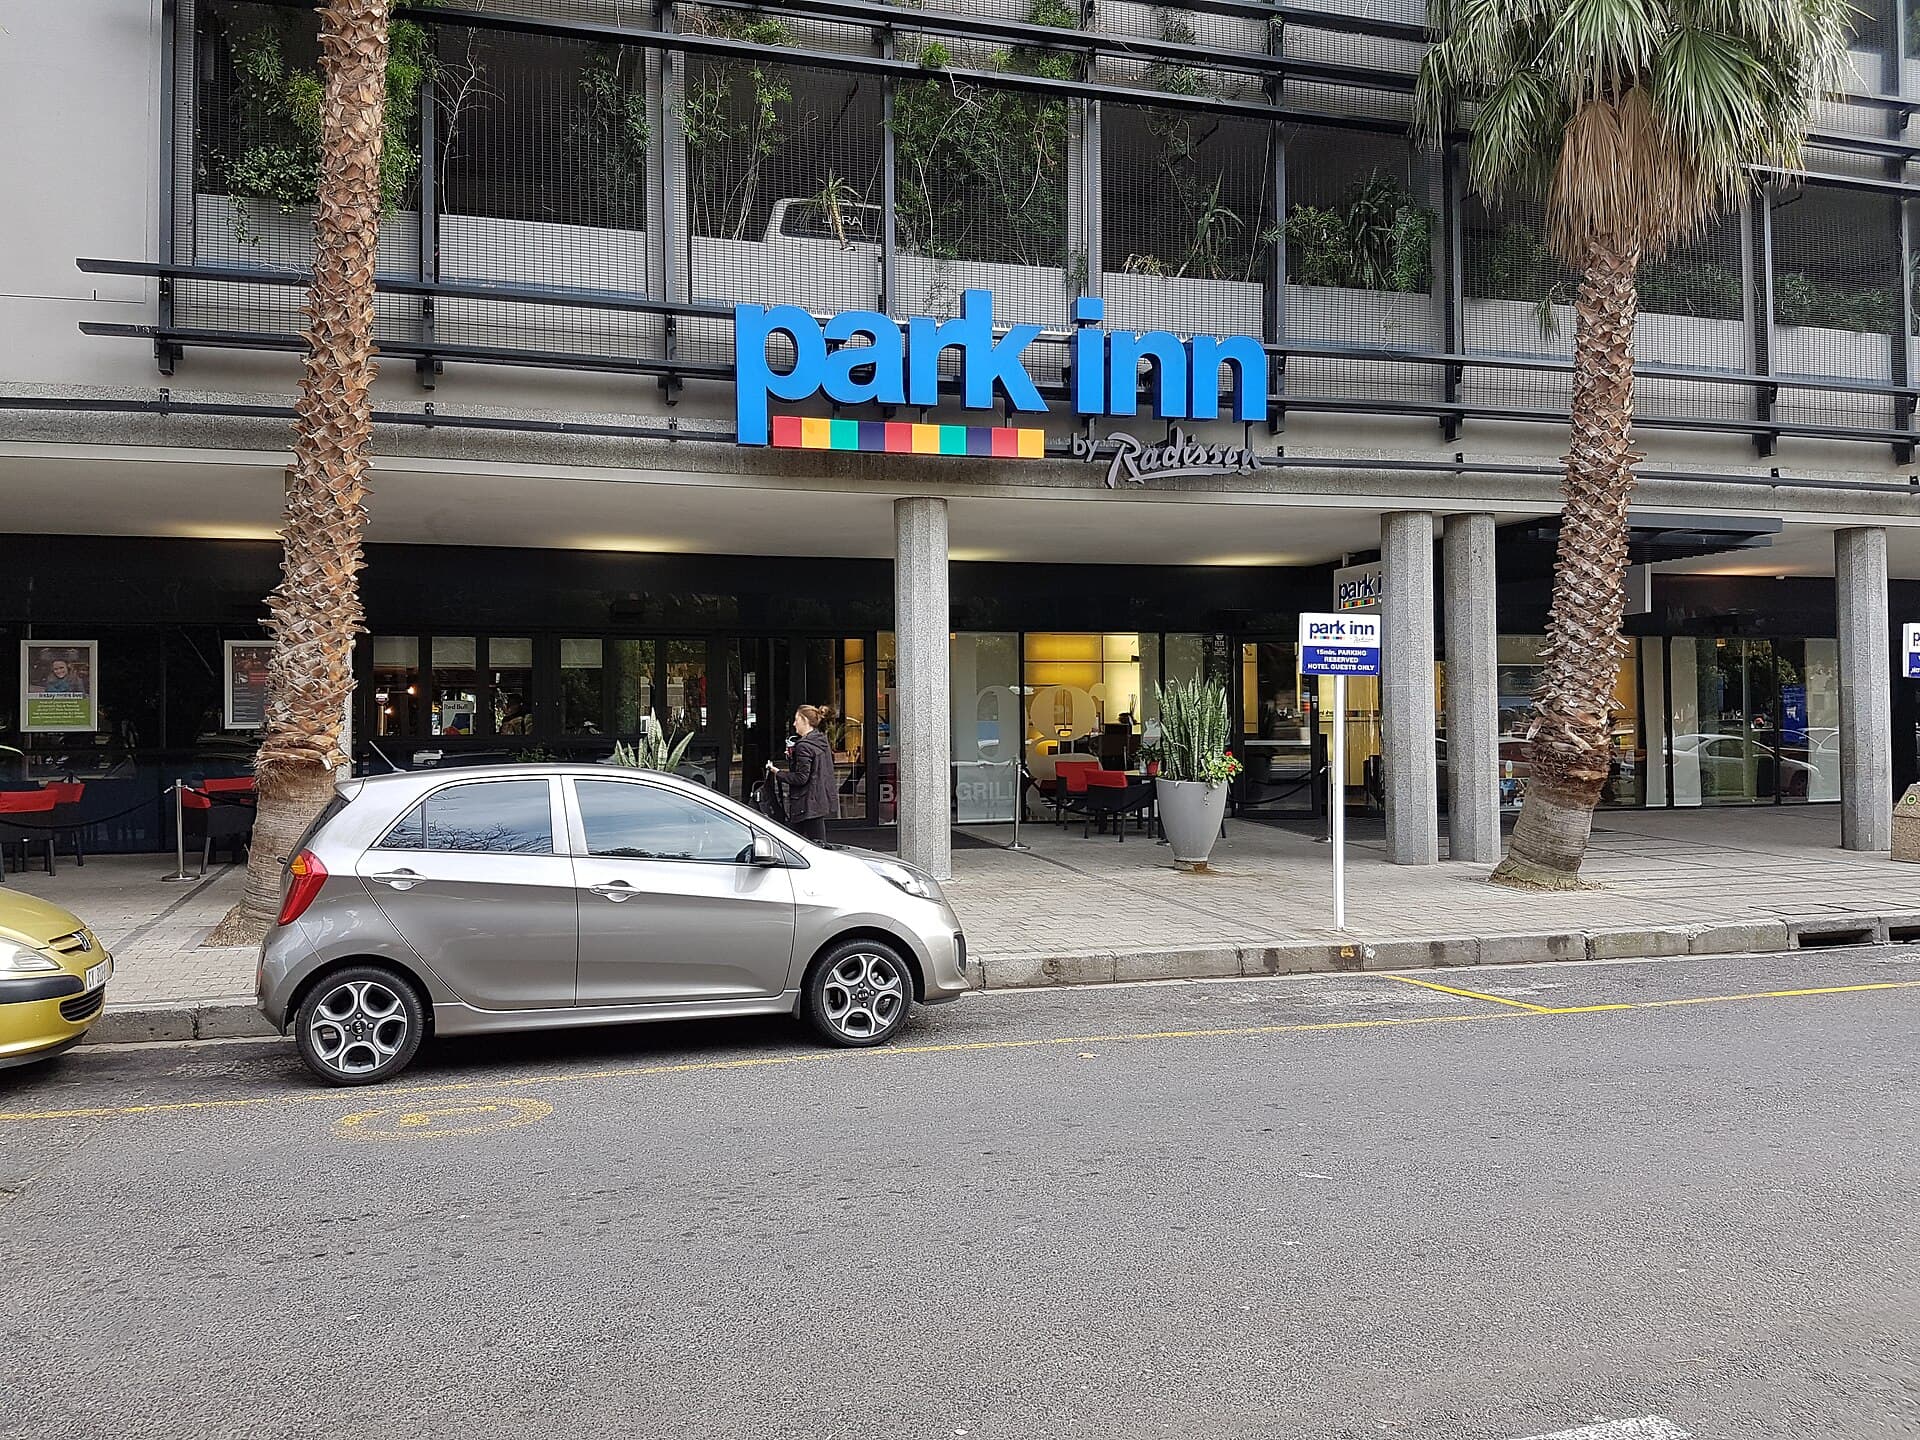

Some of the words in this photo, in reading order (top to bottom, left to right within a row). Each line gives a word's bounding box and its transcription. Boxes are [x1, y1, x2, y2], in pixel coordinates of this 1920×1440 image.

[735, 289, 1049, 445] park
[1071, 297, 1268, 422] inn
[1072, 432, 1099, 462] by
[1106, 426, 1262, 488] Radisson
[1339, 572, 1375, 609] park
[1309, 620, 1346, 639] park
[1349, 620, 1375, 636] inn
[1323, 656, 1359, 664] RESERVED
[1337, 649, 1367, 657] PARKING
[1330, 663, 1357, 671] GUESTS
